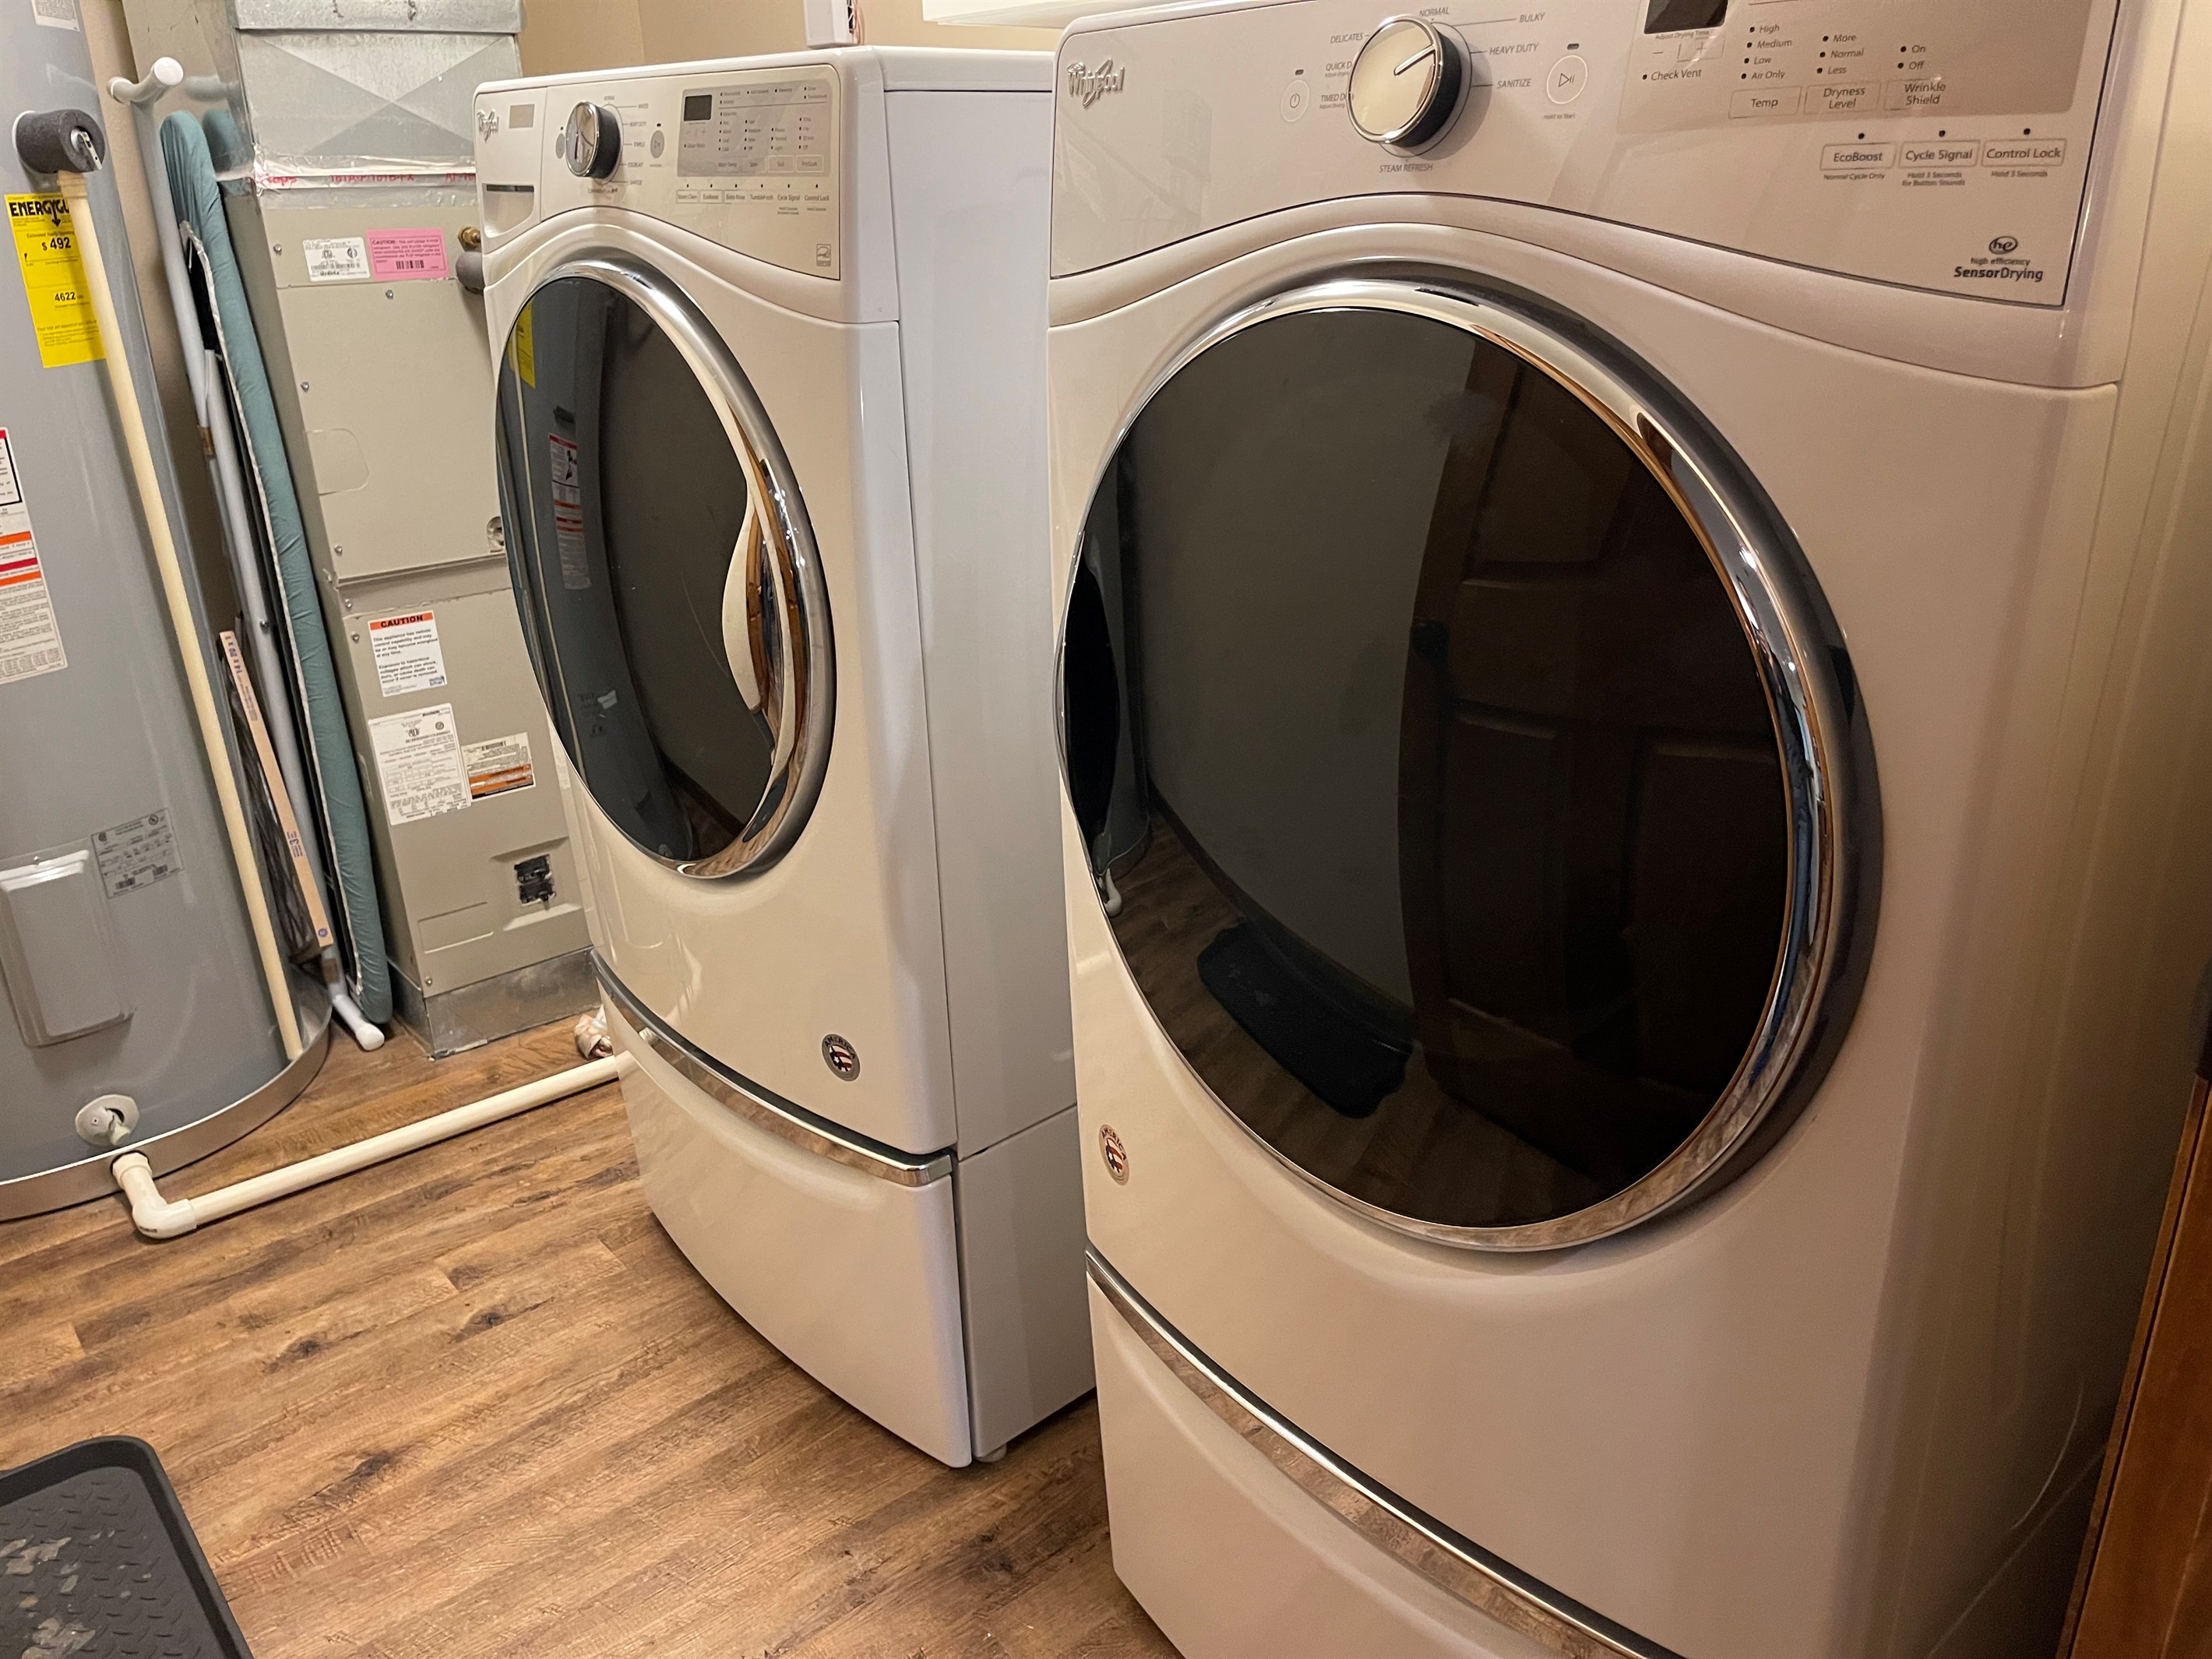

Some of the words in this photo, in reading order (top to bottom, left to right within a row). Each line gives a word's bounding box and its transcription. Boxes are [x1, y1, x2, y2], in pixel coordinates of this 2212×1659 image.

[1419, 7, 1449, 16] NORMAL
[1519, 12, 1545, 23] BULKY
[1759, 24, 1780, 33] High
[1330, 33, 1363, 43] DELICATES
[1757, 39, 1792, 48] Medium
[1489, 45, 1515, 55] HEAVY
[1516, 43, 1539, 54] DUTY
[1830, 48, 1865, 58] Normal
[1911, 44, 1926, 53] On
[1326, 62, 1346, 71] QUICK
[1908, 61, 1925, 70] Off
[1650, 70, 1678, 80] Check
[1680, 69, 1702, 79] Vent
[1765, 70, 1785, 80] Only
[1496, 78, 1532, 89] SANITIZE
[1904, 81, 1946, 93] Wrinkle
[1320, 93, 1340, 102] TIMED
[1823, 86, 1866, 99] Dryness
[1751, 98, 1778, 108] Temp
[1828, 98, 1857, 109] Level
[1905, 93, 1941, 106] Shield
[1833, 151, 1883, 162] EcoBoost
[1904, 149, 1936, 162] Cycle
[1938, 147, 1974, 161] Signal
[1985, 147, 2031, 160] Control
[2032, 147, 2062, 159] Lock
[1379, 164, 1402, 173] STEAM
[1403, 164, 1433, 172] REFRESH
[2017, 169, 2048, 178] Seconds
[1869, 171, 1886, 180] Only
[50, 237, 72, 250] 492
[1971, 257, 1988, 266] high
[1990, 257, 2031, 266] efficiency
[1953, 266, 2044, 282] SensorDrying
[55, 291, 76, 302] 4622
[380, 615, 423, 628] CAUTION
[1101, 1127, 1127, 1161] AMERICA
